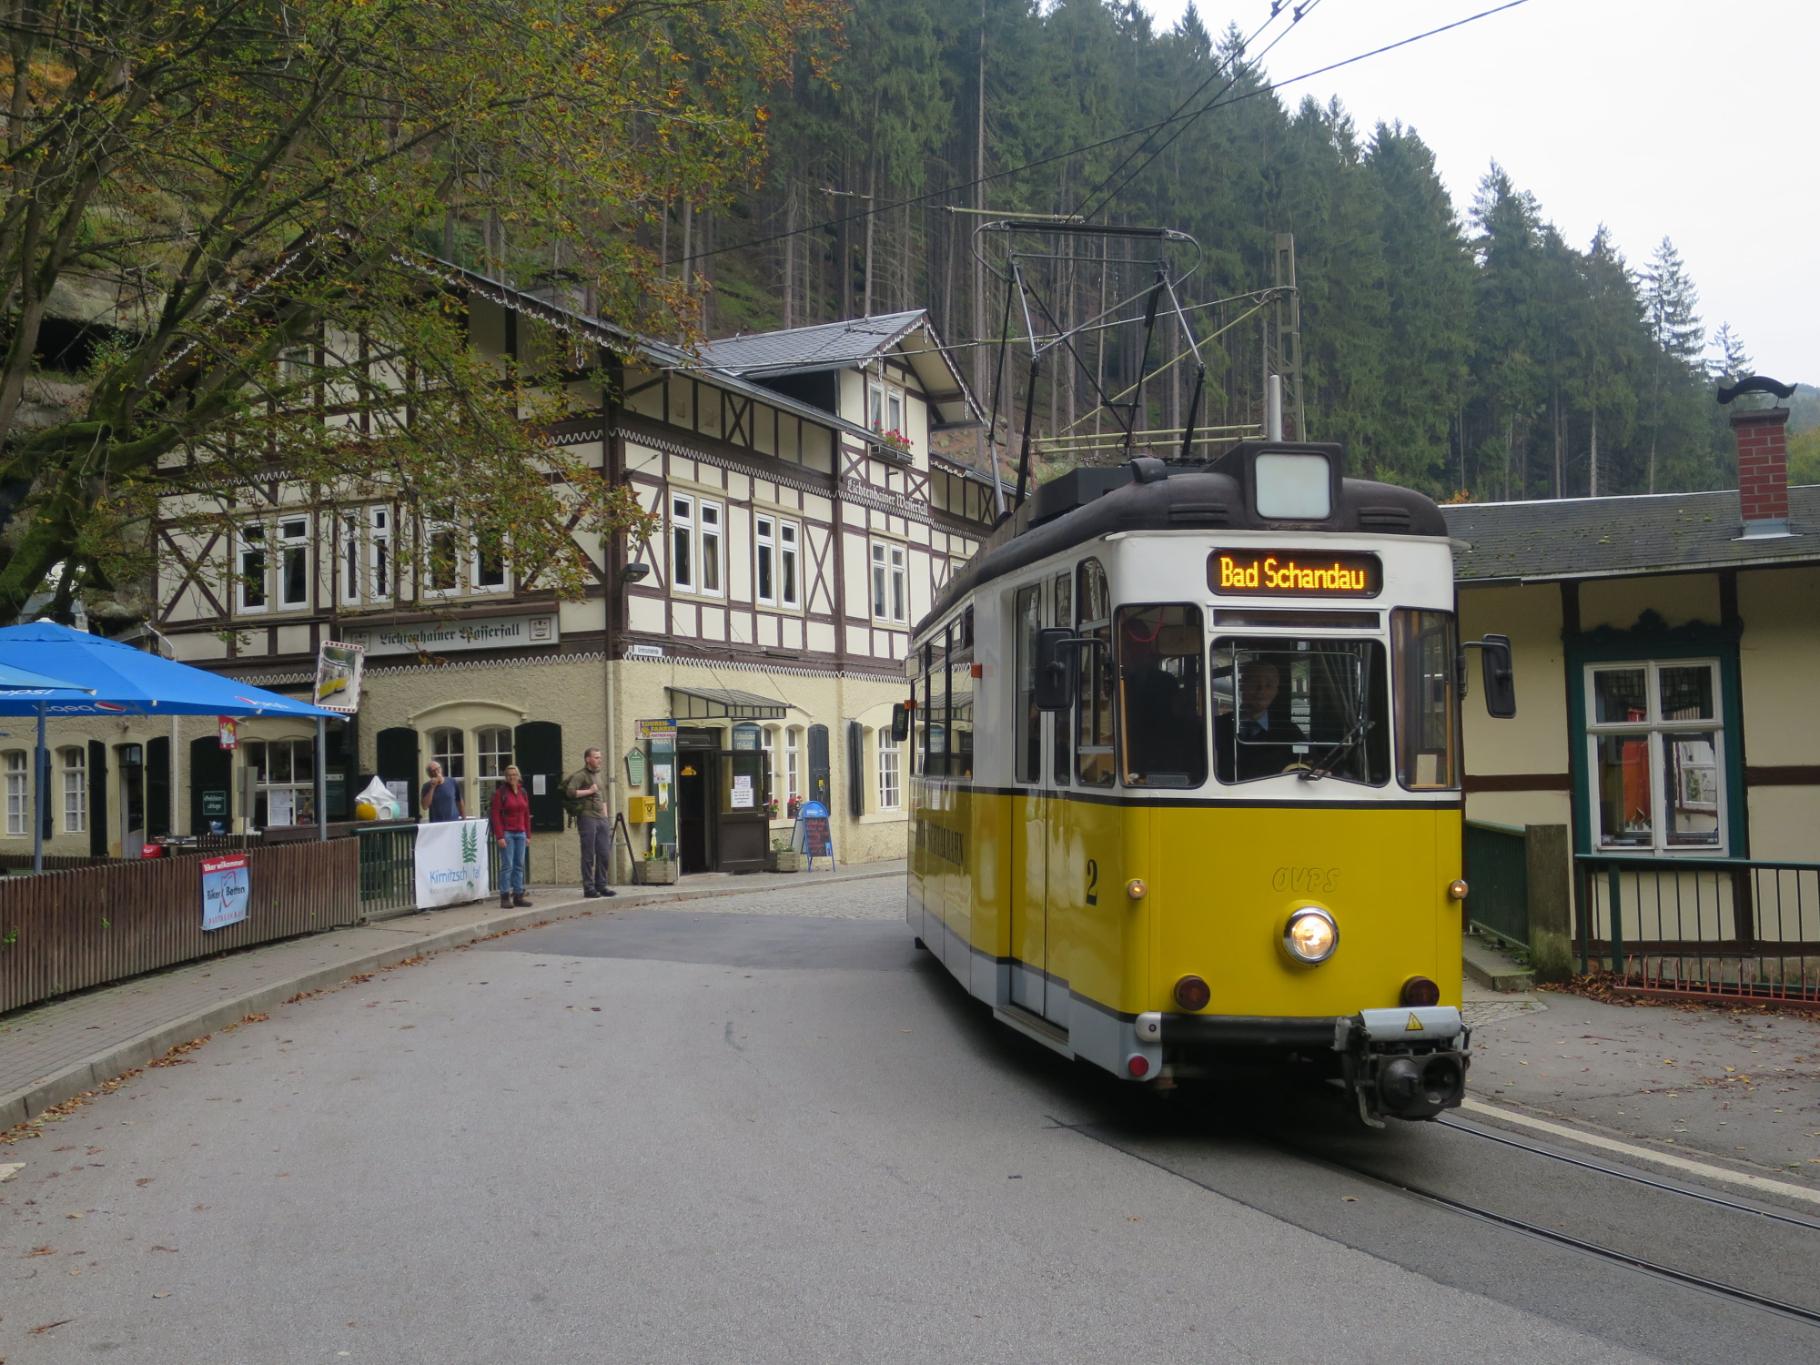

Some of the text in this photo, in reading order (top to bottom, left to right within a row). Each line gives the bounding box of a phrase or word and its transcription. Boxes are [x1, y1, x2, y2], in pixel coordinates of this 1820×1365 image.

[847, 479, 896, 505] Lichtenhainer
[1219, 557, 1365, 590] Bad Schandau
[1085, 858, 1098, 907] 2
[1272, 866, 1342, 893] OVPS
[207, 888, 221, 900] Biker
